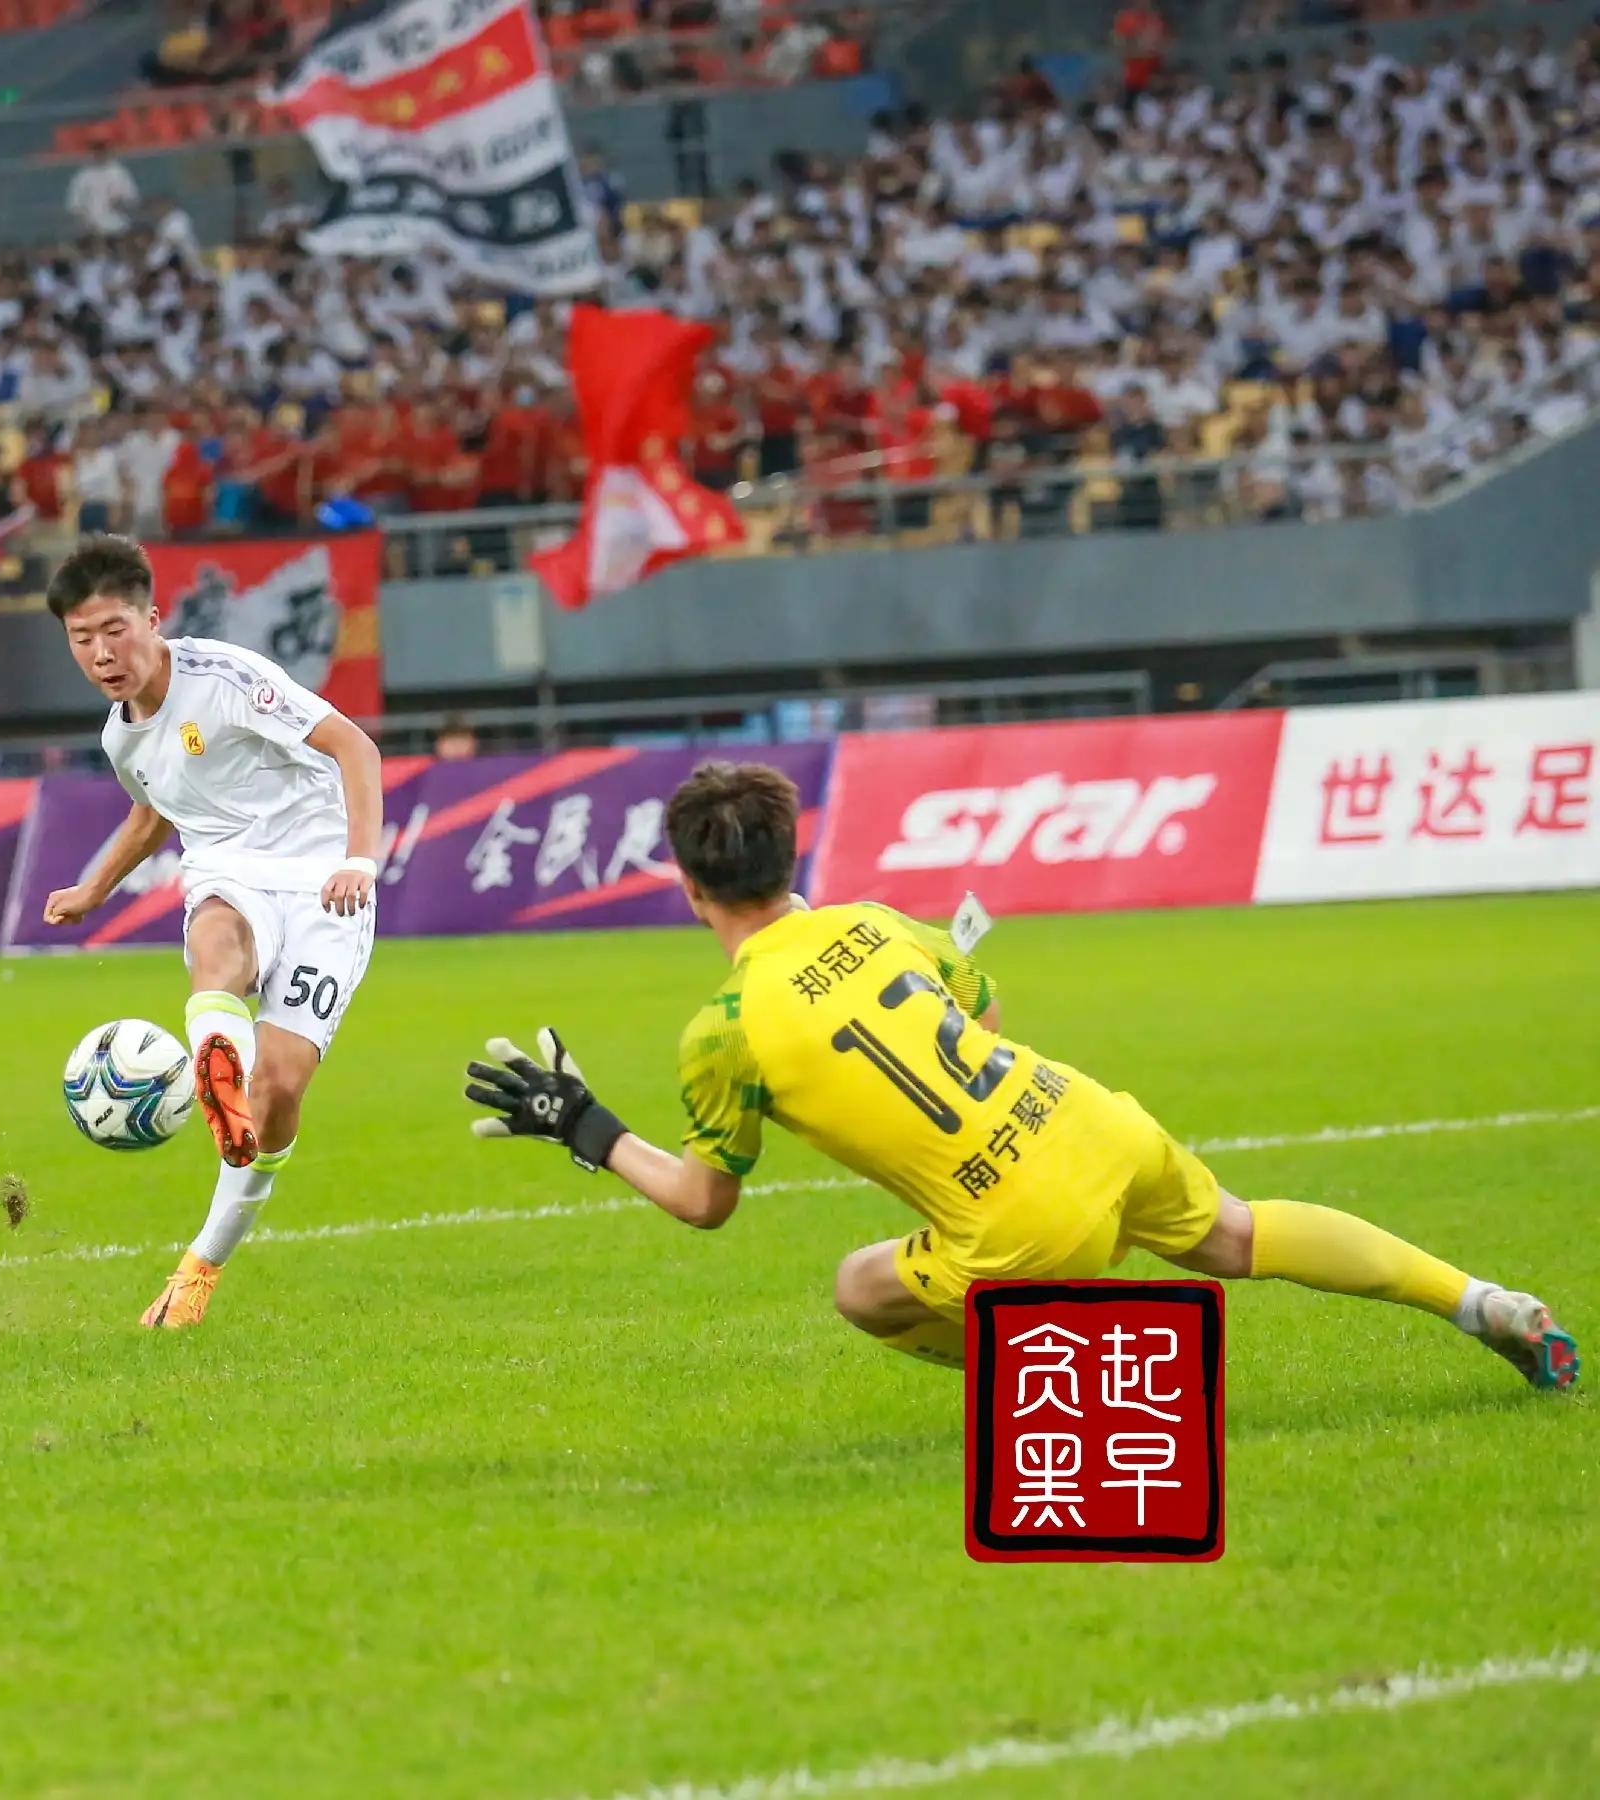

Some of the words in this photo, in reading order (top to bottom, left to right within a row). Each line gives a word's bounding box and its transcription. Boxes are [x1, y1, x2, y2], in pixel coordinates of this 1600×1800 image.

[1319, 742, 1594, 843] 世达足
[283, 964, 339, 1020] 50
[789, 919, 892, 1005] 郑冠亚
[831, 970, 1015, 1135] 12
